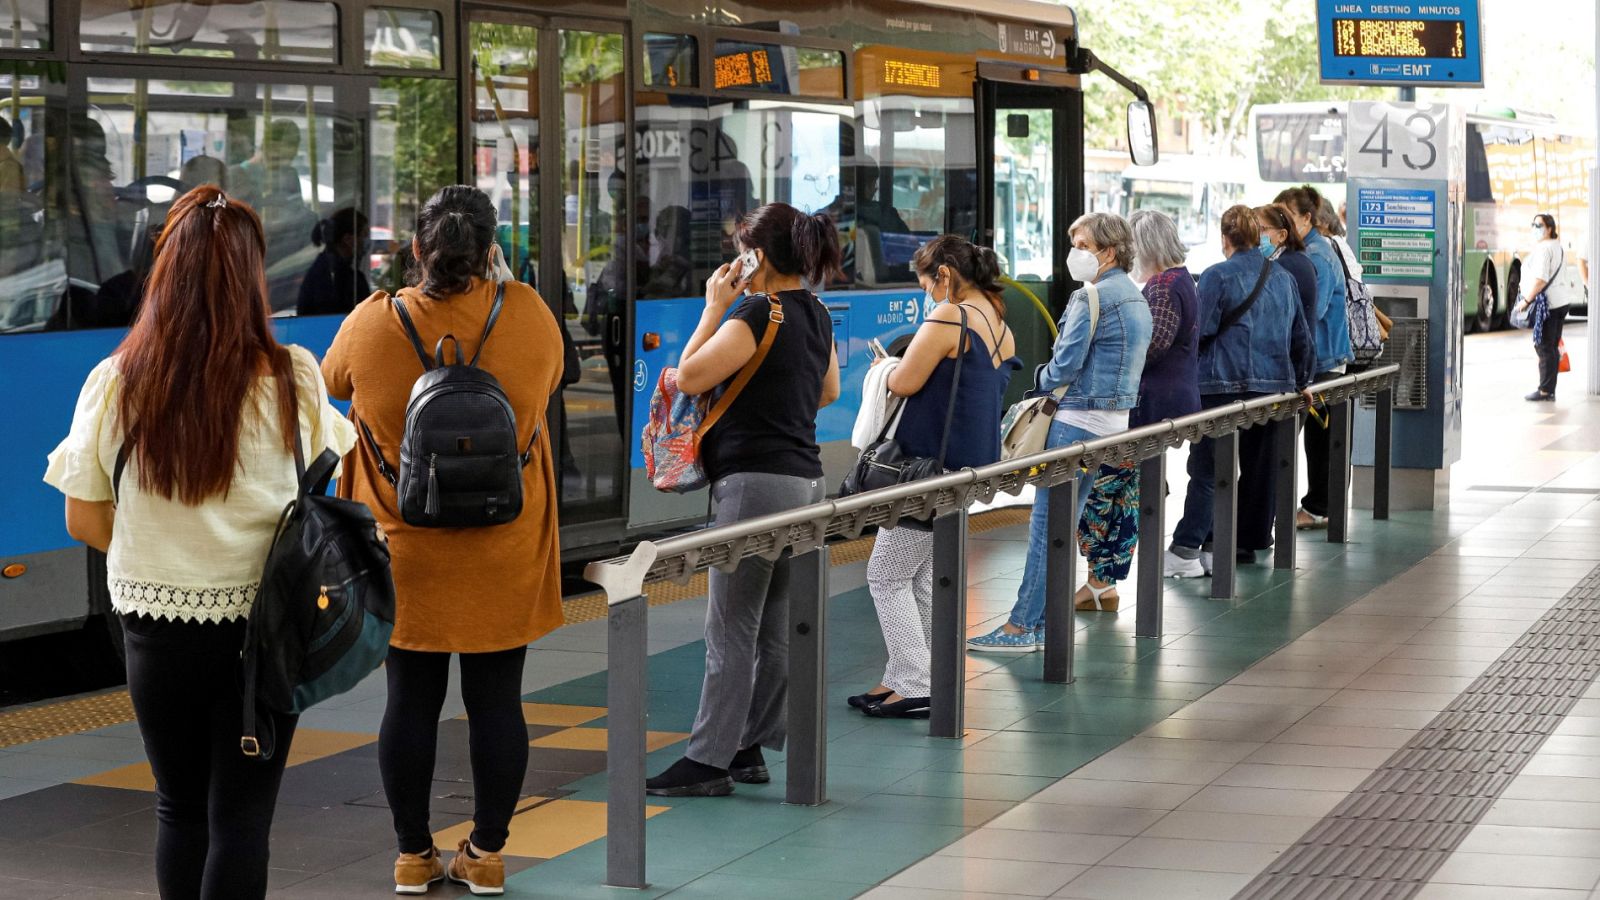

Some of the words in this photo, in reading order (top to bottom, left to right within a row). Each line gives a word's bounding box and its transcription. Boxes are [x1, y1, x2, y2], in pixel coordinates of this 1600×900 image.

[1335, 5, 1362, 13] LINEA
[1371, 6, 1411, 14] DESTINO
[1418, 6, 1460, 15] MINUTOS
[1337, 21, 1354, 30] 173
[1360, 21, 1424, 30] SANCHINARRO
[1025, 30, 1039, 40] EMT
[1014, 41, 1040, 55] MADRID
[1338, 47, 1355, 55] 173
[1361, 46, 1426, 55] SANCHINARRO
[1451, 47, 1462, 57] 11
[1403, 64, 1431, 76] EMT
[1358, 112, 1437, 171] 43
[1302, 155, 1347, 172] ALS
[1366, 203, 1381, 211] 173
[1366, 216, 1381, 224] 174
[889, 301, 903, 311] EMT
[877, 313, 903, 324] MADRID
